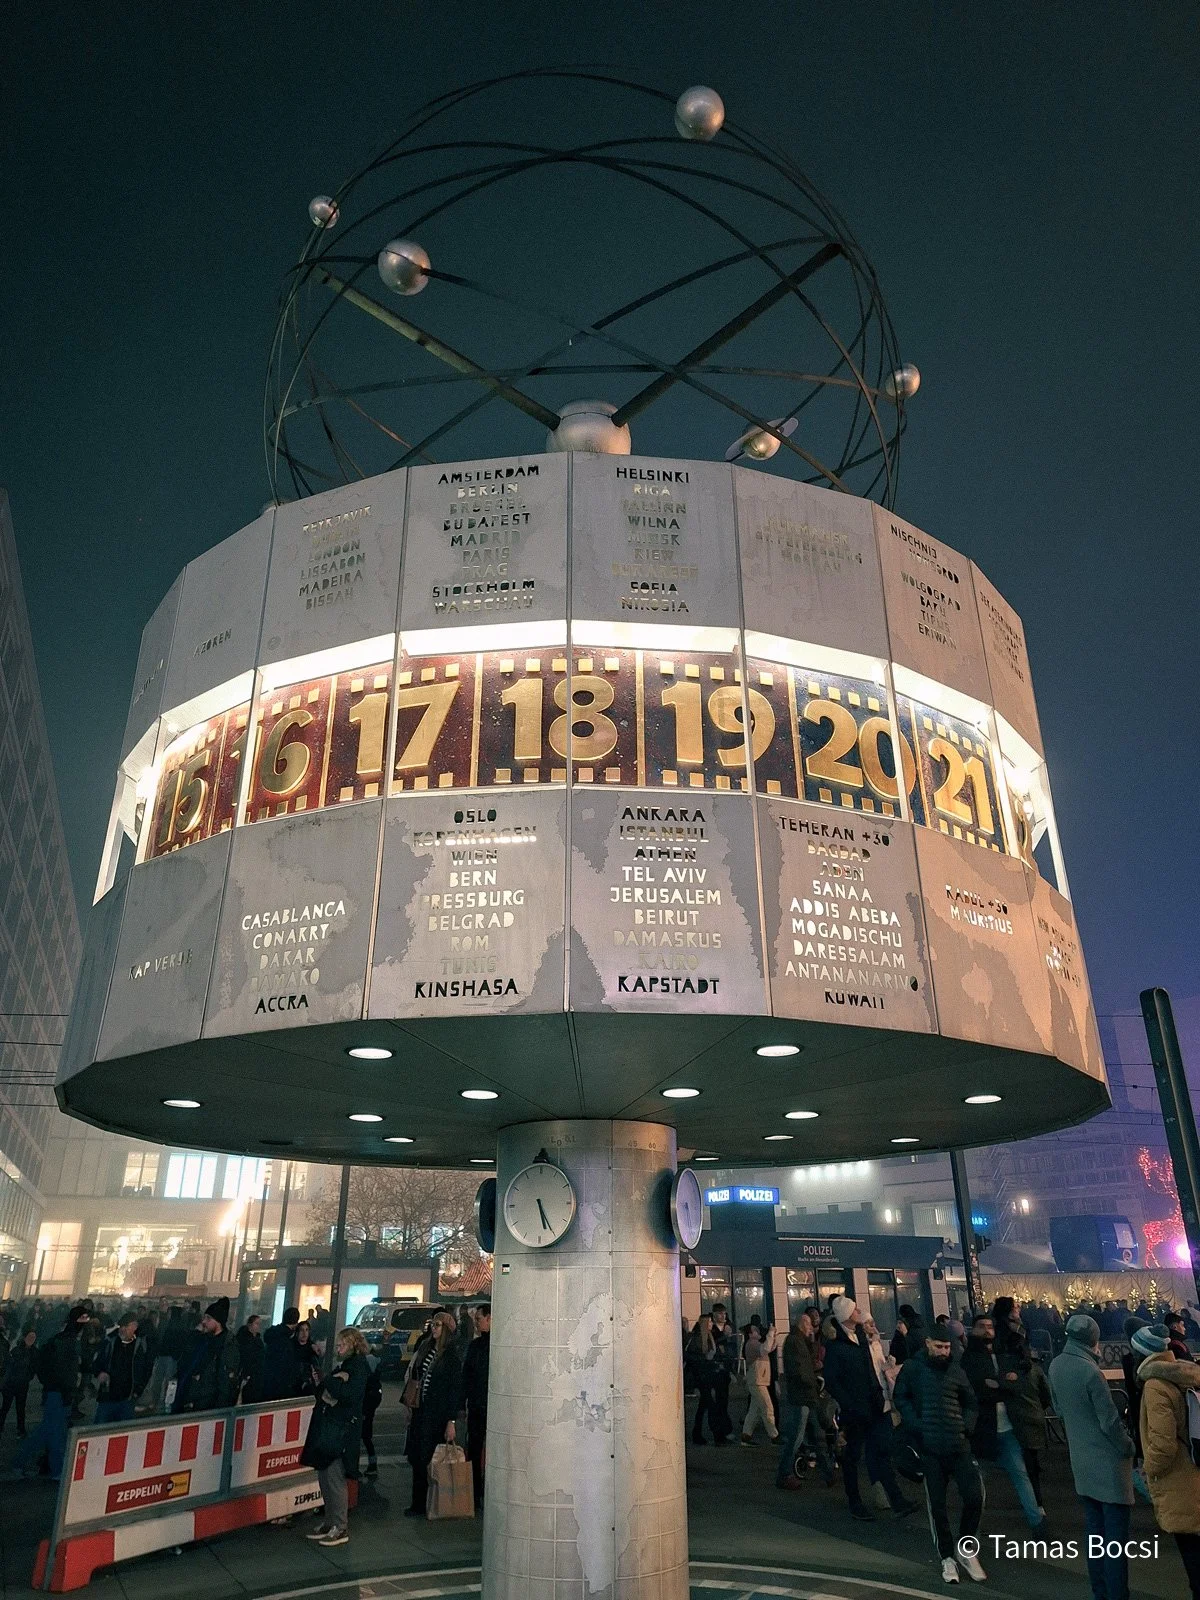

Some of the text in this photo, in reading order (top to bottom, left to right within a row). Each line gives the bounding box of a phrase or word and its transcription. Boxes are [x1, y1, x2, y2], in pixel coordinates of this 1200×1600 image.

[439, 465, 539, 484] AMSTERDAM
[616, 467, 690, 483] HELSINKI
[458, 482, 519, 498] BERLIN
[632, 484, 670, 496] RIGA
[303, 505, 371, 533] REYKJAVIK
[443, 513, 530, 531] BUDAPEST
[628, 515, 680, 530] WILNA
[451, 530, 521, 547] MADRID
[891, 524, 937, 559] NISCHNIJ
[463, 548, 510, 563] PARIS
[300, 553, 365, 580] LISSABON
[463, 563, 508, 578] PRAG
[299, 569, 363, 596] MADEIRA
[432, 579, 535, 598] STOCKHOLM
[630, 581, 678, 596] SOFIA
[901, 571, 960, 611] WOLGOGRAD
[435, 596, 533, 614] WARSCHAU
[622, 597, 689, 612] NIKOSIA
[920, 596, 946, 617] BAKU
[918, 623, 956, 649] ERIWAN
[501, 675, 617, 760] 18
[661, 681, 775, 766] 19
[349, 681, 462, 776] 17
[804, 700, 916, 799] 20
[928, 738, 994, 834] 21
[159, 749, 210, 847] 15
[454, 808, 497, 824] OSLO
[622, 806, 706, 822] ANKARA
[620, 826, 709, 842] ISTANBUL
[779, 816, 890, 846] TEHERAN +30
[452, 850, 498, 865] WIEN
[633, 846, 697, 862] ATHEN
[808, 840, 871, 862] BAGDAD
[450, 870, 497, 887] BERN
[622, 866, 706, 883] TEL AVIV
[820, 862, 864, 881] ADEN
[421, 890, 524, 910] PRESSBURG
[610, 887, 721, 905] JERUSALEM
[813, 880, 873, 903] SANAA
[946, 885, 1008, 915] KABUL +30
[242, 900, 346, 930] CASABLANCA
[428, 912, 514, 932] BELGRAD
[635, 909, 699, 926] BEIRUT
[790, 898, 901, 928] ADDIS ABEBA
[951, 905, 1013, 934] MAURITIUS
[253, 923, 329, 949] CONAKRY
[614, 930, 722, 948] DAMASKUS
[792, 918, 902, 947] MOGADISCHU
[451, 935, 489, 951] ROM
[260, 948, 315, 970] DAKAR
[794, 940, 905, 969] DARESSALAM
[129, 961, 150, 980] KAP
[441, 956, 497, 975] TUNIS
[251, 968, 319, 992] BAMAKO
[618, 976, 720, 994] KAPSTADT
[785, 961, 919, 991] ANTANANARIVO
[415, 979, 519, 998] KINSHASA
[255, 994, 308, 1014] ACCRA
[825, 988, 887, 1009] KUWAIT
[708, 1190, 729, 1202] POLIZEI
[740, 1189, 773, 1201] POLIZEI
[803, 1246, 832, 1255] POLIZEI
[266, 1454, 299, 1468] ZEPPELIN
[117, 1483, 162, 1503] ZEPPELIN
[295, 1491, 321, 1505] ZEPPELI
